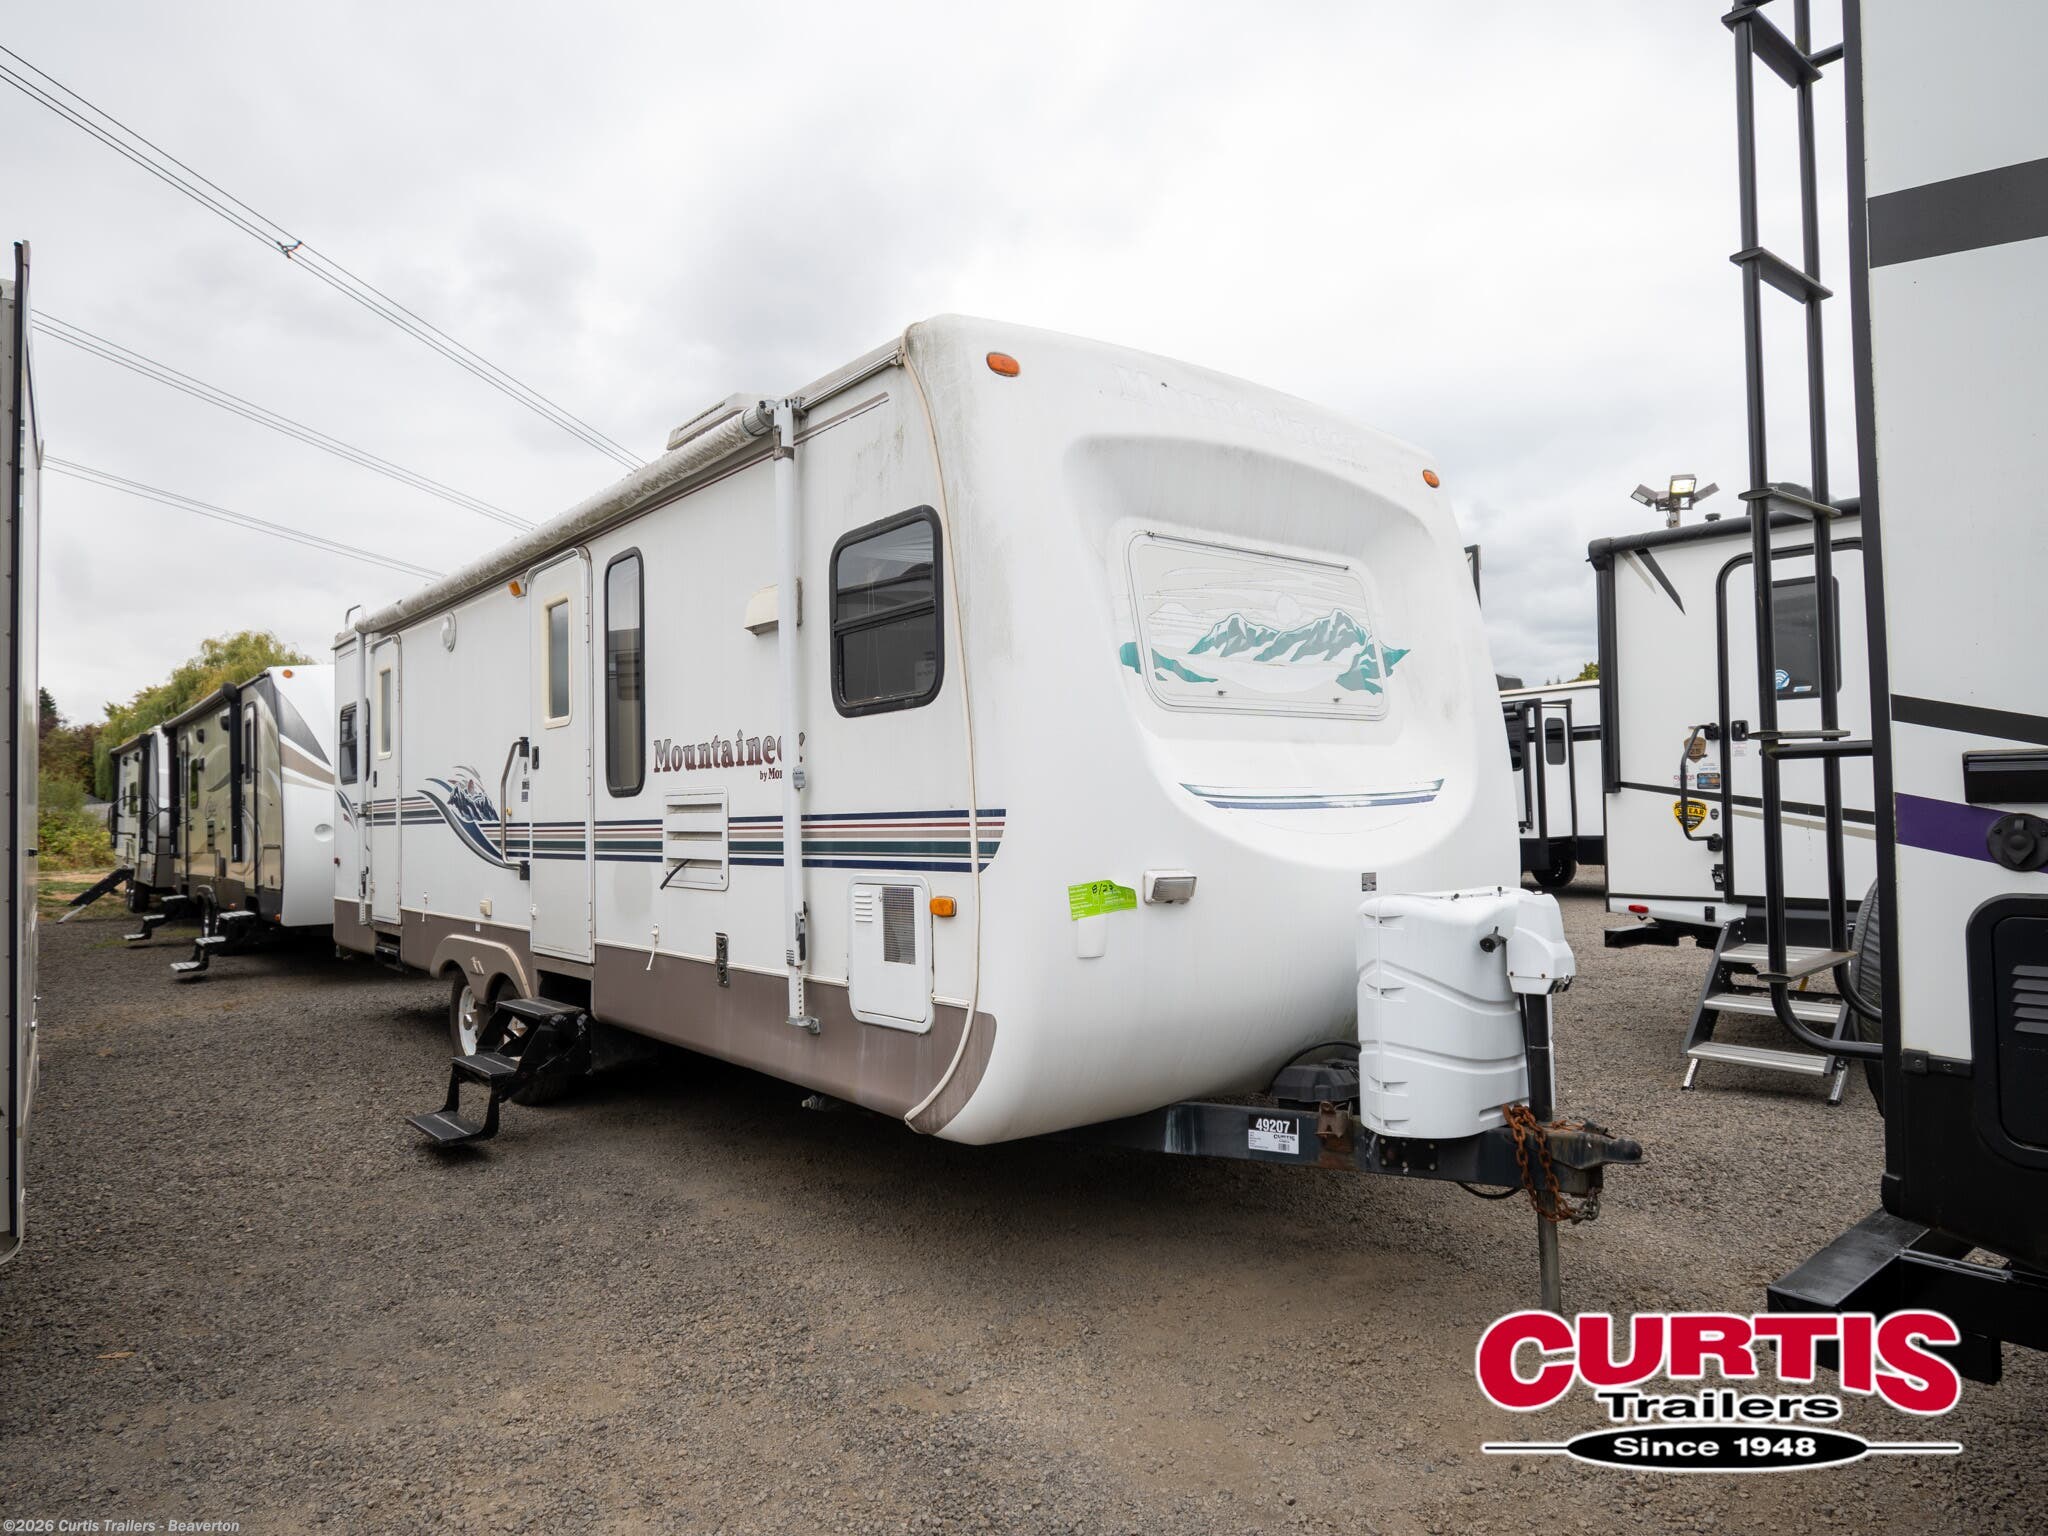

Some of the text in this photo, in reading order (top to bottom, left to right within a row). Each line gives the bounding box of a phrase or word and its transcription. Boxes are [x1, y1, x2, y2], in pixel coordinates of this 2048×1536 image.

[653, 728, 805, 773] Mountaine
[759, 770, 768, 782] by
[1256, 1118, 1290, 1134] 49207
